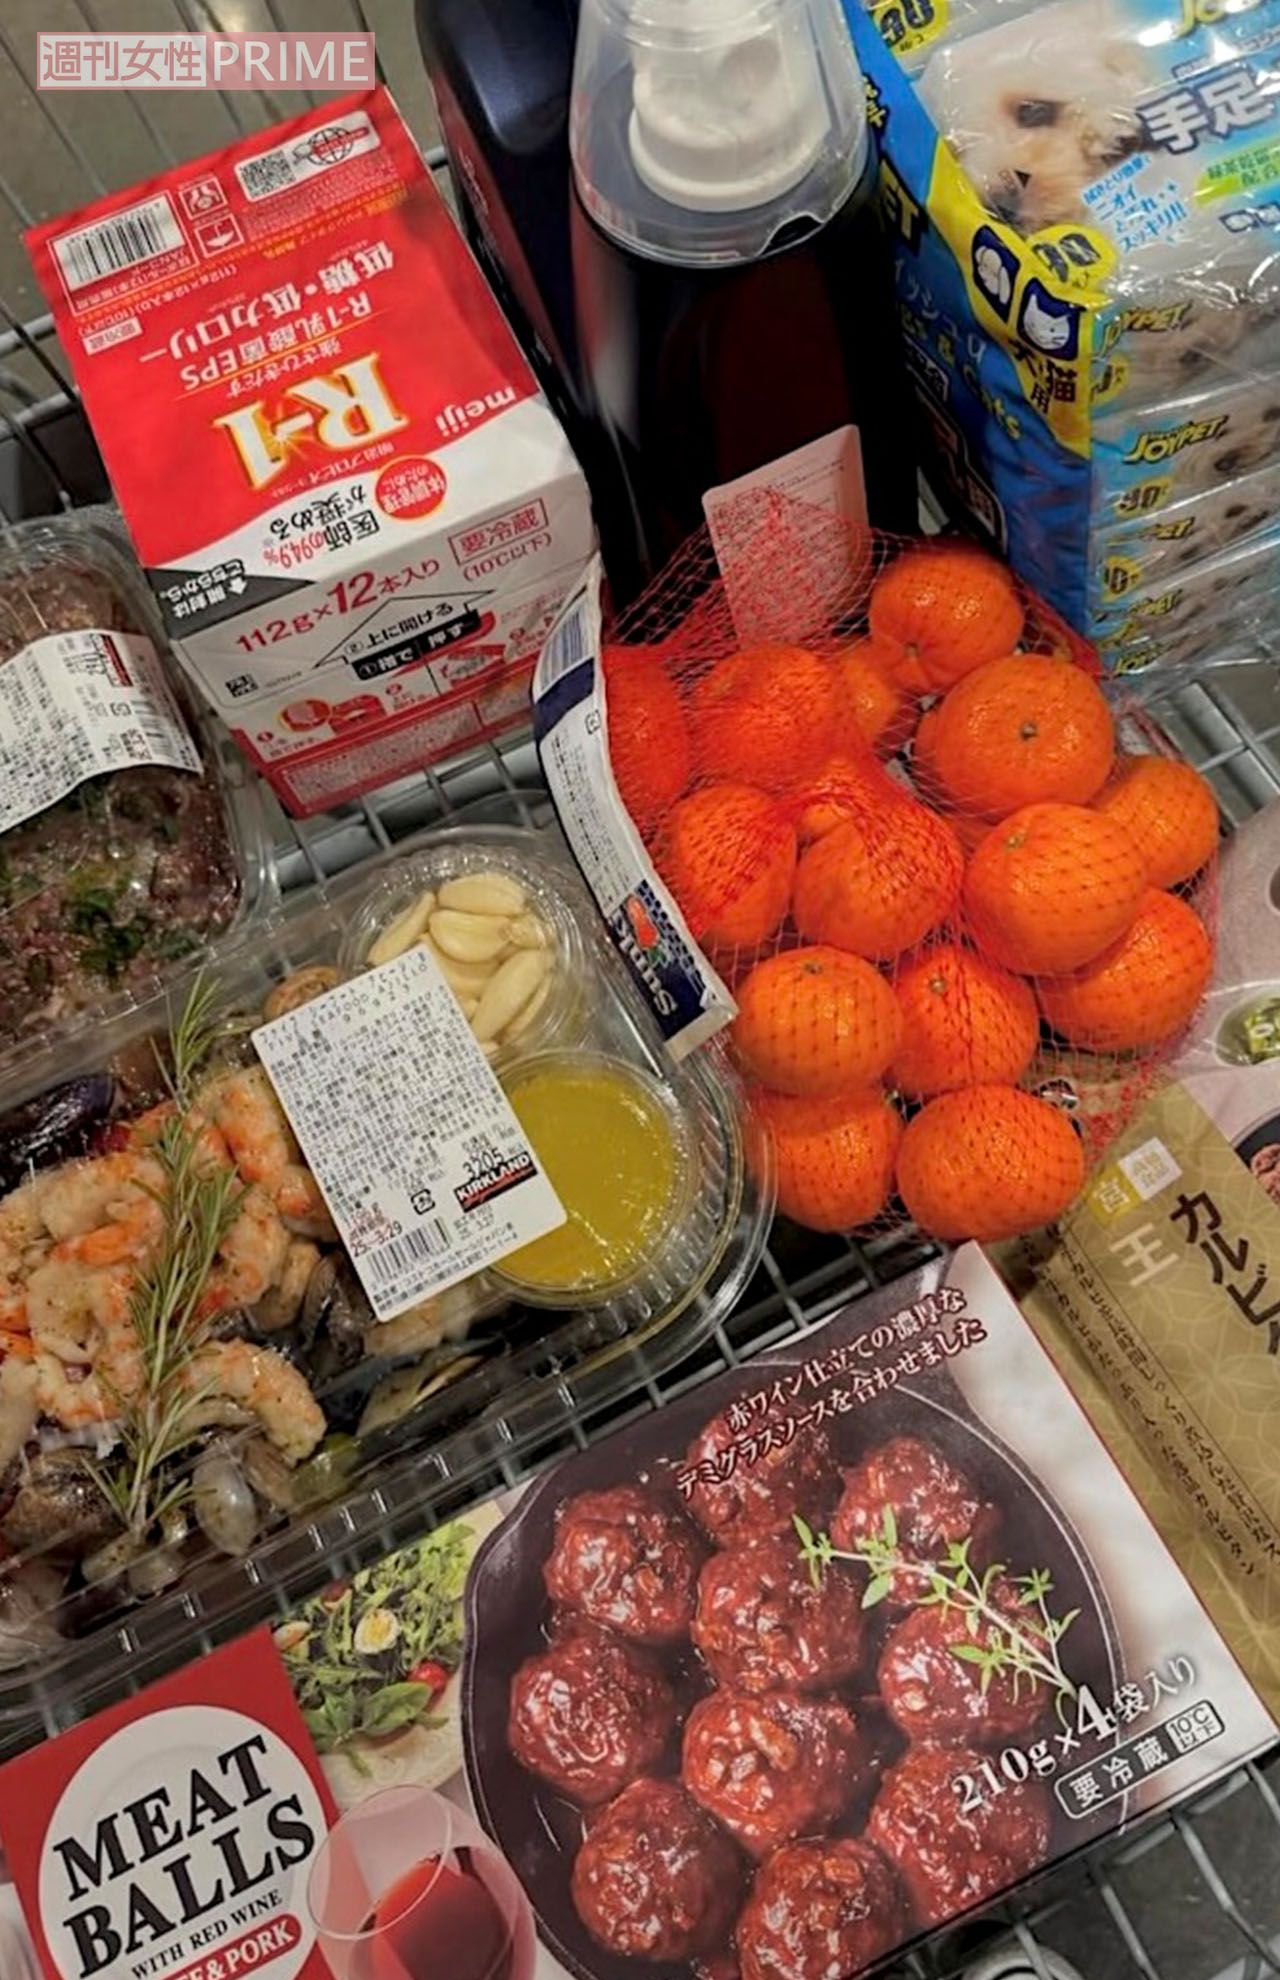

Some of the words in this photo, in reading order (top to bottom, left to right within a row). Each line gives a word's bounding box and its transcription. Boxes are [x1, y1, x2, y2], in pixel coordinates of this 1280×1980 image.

[139, 239, 396, 363] 低糖・低カロリー
[178, 292, 372, 390] R-1乳酸菌EPS
[222, 337, 342, 399] 強さひきだす
[436, 385, 517, 436] meiji
[213, 352, 410, 490] R-1
[1122, 415, 1230, 463] JOYPET
[267, 483, 369, 543] が奨める
[459, 508, 541, 556] 要冷蔵
[235, 556, 442, 655] 112g×12本入り
[455, 1153, 531, 1201] KIRKLAND
[462, 1147, 505, 1181] 3205
[1109, 1222, 1180, 1287] 王
[1170, 1191, 1280, 1355] カルビ
[724, 1283, 968, 1433] 赤ワイン仕立ての濃厚な
[673, 1314, 988, 1501] デミグラスソースを合わせました
[949, 1654, 1199, 1814] 210g×4袋入り
[1068, 1735, 1170, 1808] 要冷蔵
[53, 1734, 273, 1903] MEAT
[63, 1793, 314, 1979] BALLS
[132, 1940, 184, 1980] WITH
[189, 1917, 229, 1951] RED
[232, 1888, 282, 1930] WINE
[227, 1919, 294, 1972] PORK
